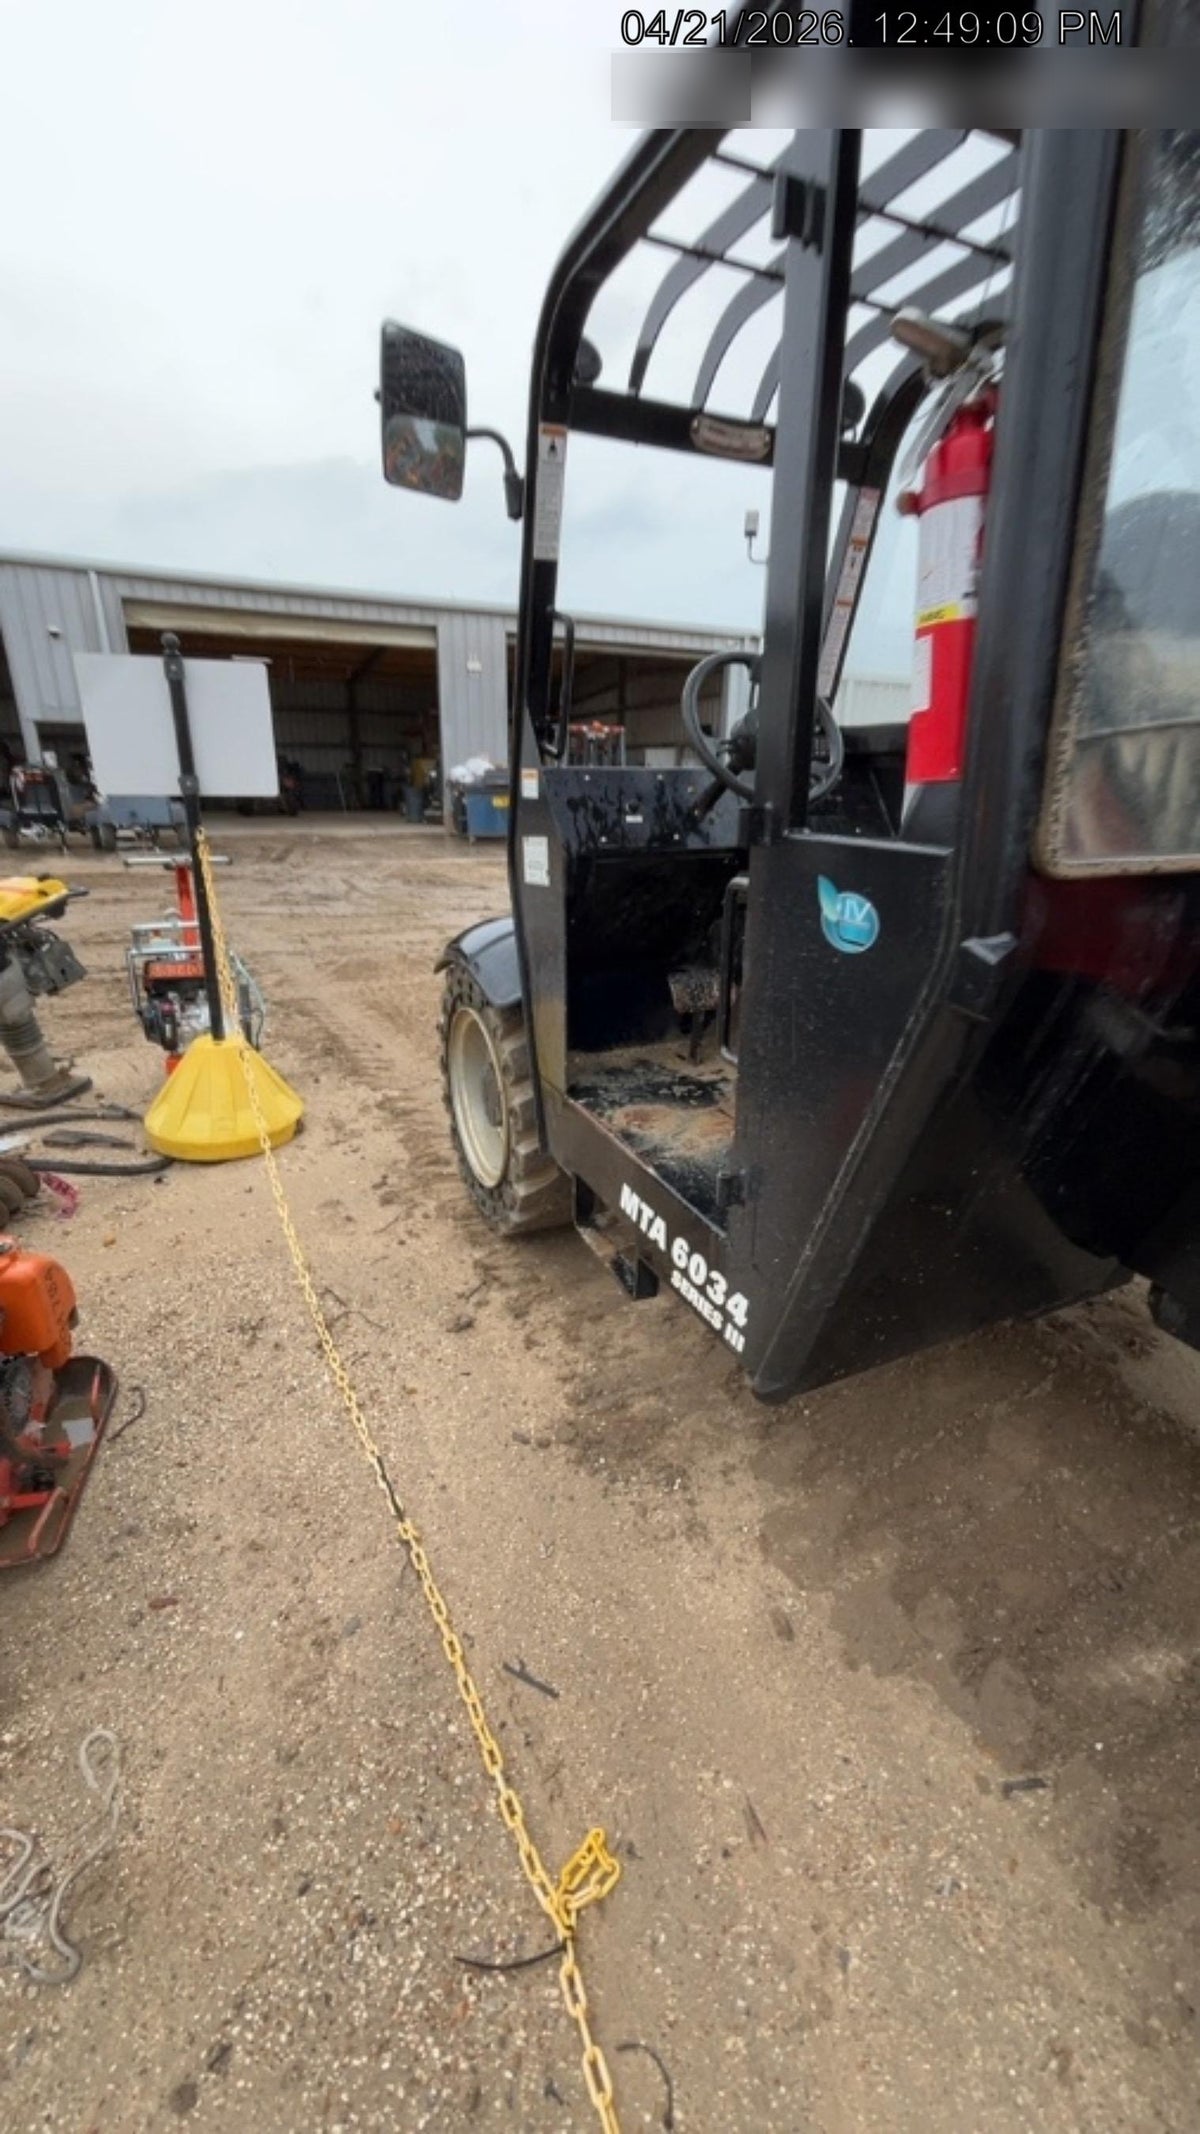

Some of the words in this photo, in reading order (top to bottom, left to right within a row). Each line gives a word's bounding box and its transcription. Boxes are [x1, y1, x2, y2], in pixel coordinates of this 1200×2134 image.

[620, 1182, 667, 1252] MTA
[671, 1237, 749, 1327] 6034
[670, 1270, 724, 1330] SERIES
